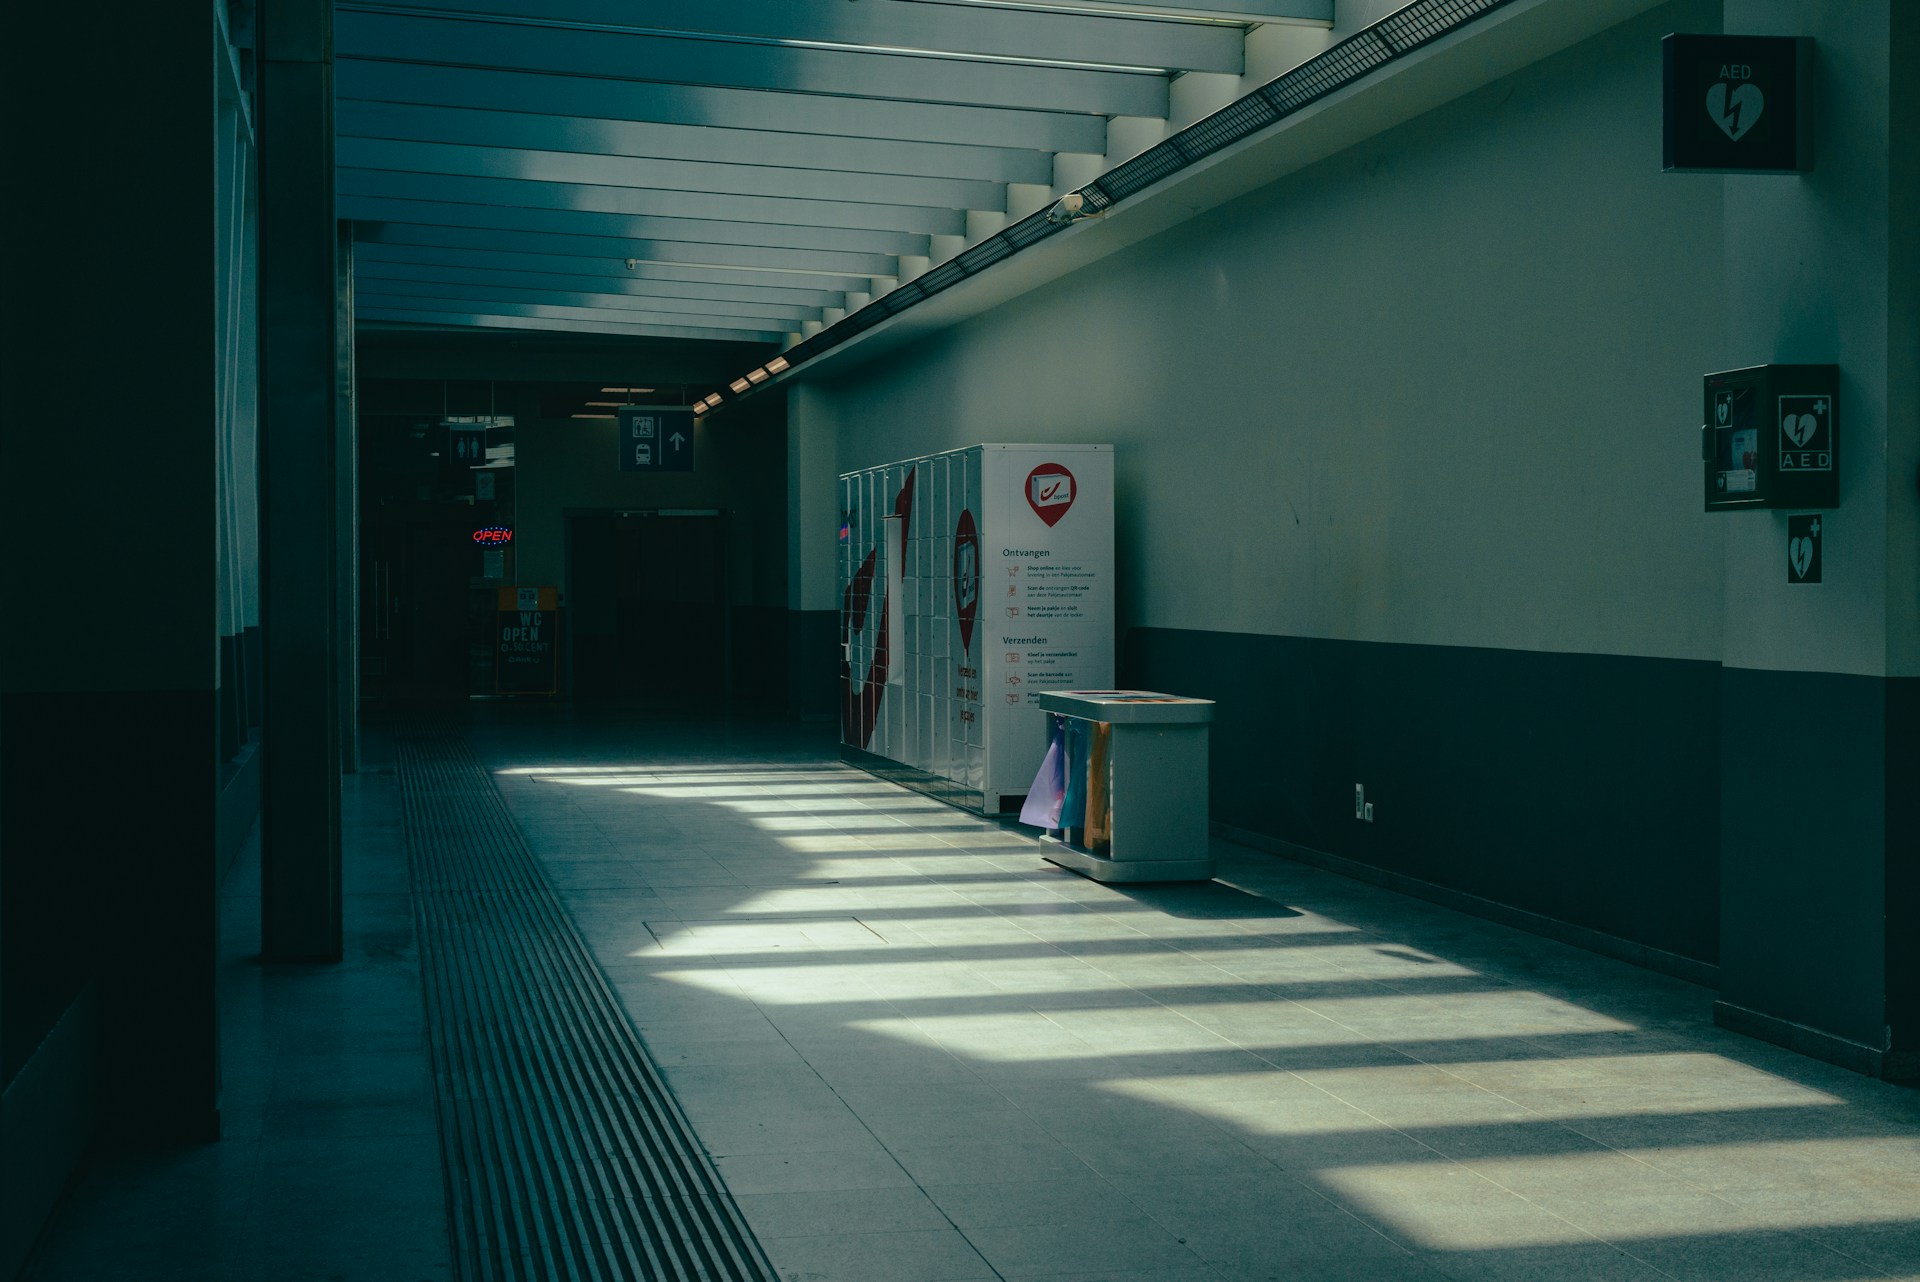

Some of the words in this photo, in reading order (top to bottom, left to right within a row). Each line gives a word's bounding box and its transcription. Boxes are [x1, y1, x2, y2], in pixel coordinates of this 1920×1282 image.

[1719, 64, 1751, 79] AED
[1782, 453, 1829, 468] AED
[1053, 492, 1069, 500] bpost
[472, 529, 513, 541] OPEN
[1002, 548, 1050, 559] Ontvangen
[519, 611, 543, 626] WC
[503, 627, 539, 642] OPEN
[1002, 635, 1048, 645] Verzenden
